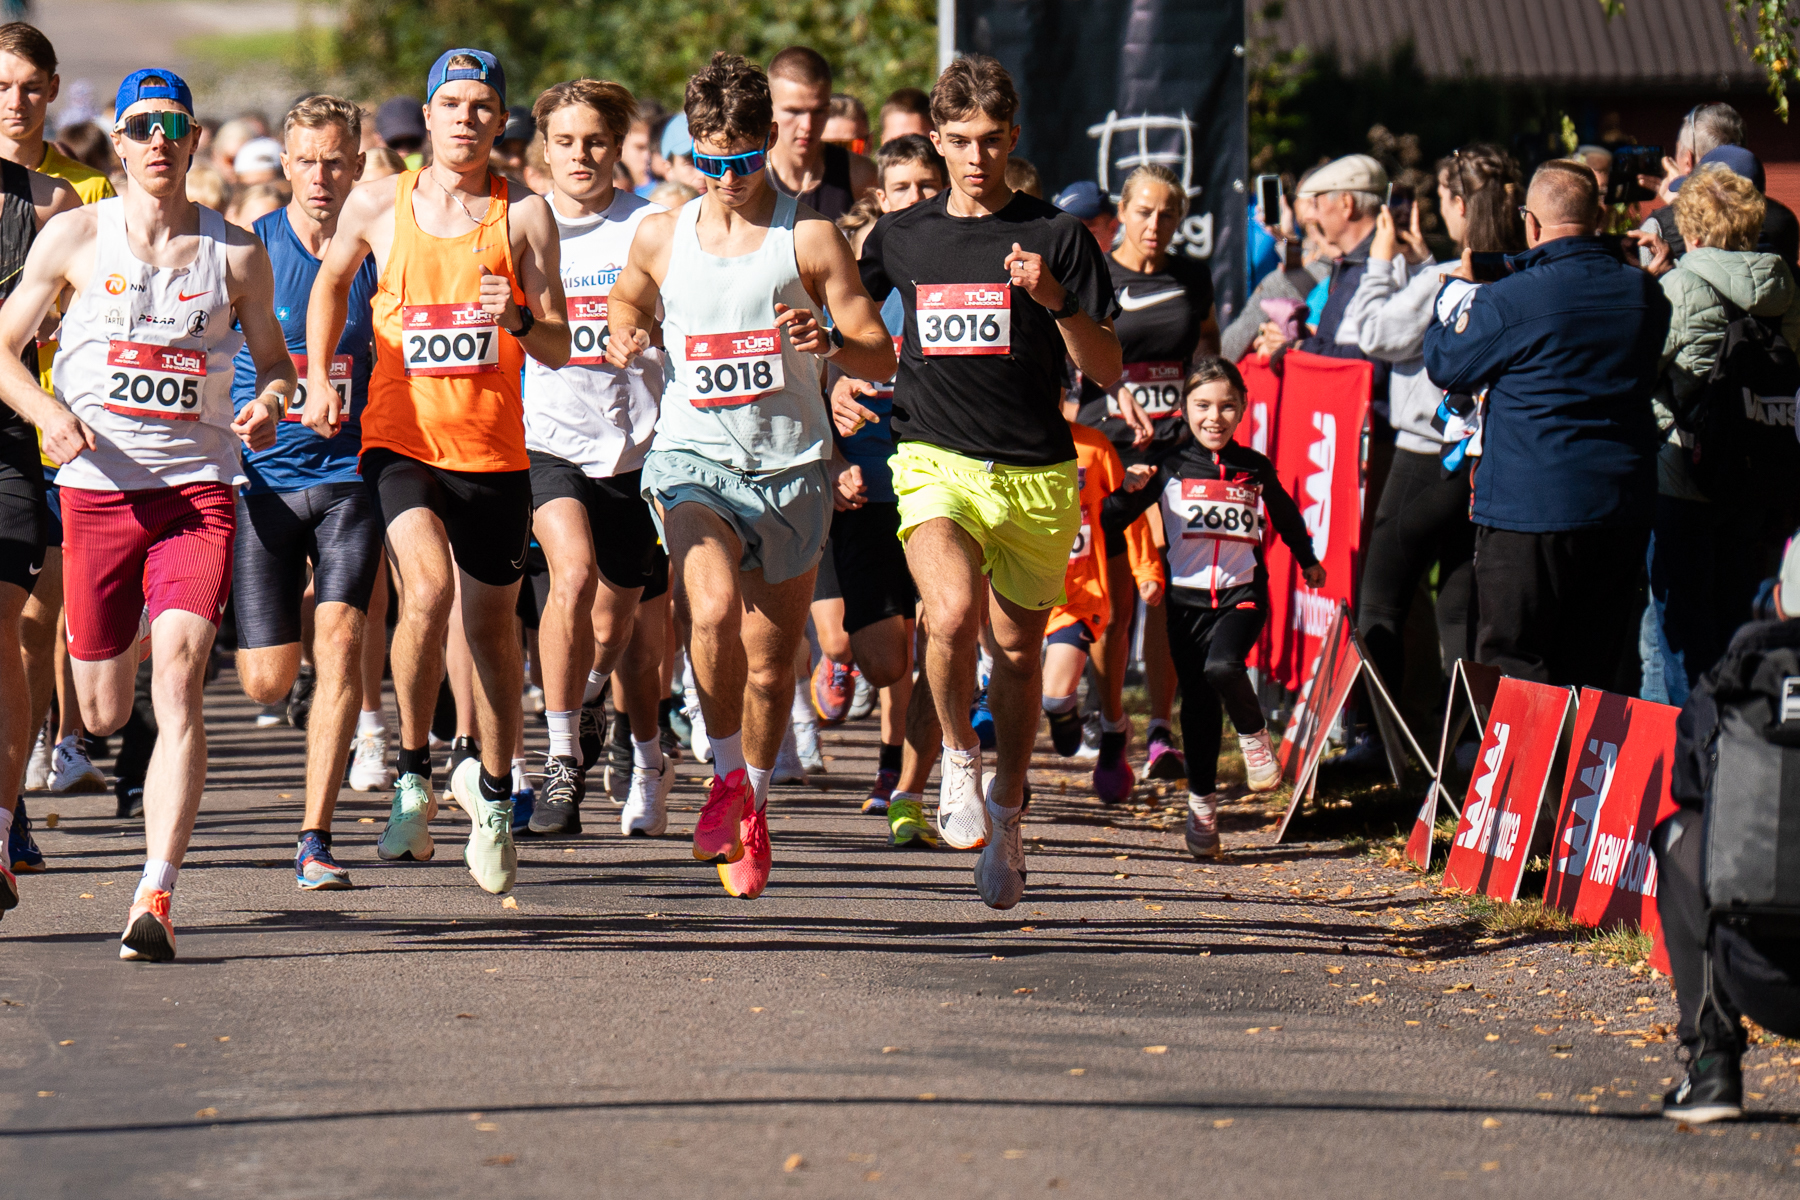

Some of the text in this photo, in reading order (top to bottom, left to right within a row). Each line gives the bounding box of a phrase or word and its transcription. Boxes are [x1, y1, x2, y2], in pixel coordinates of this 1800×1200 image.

[574, 301, 608, 313] TÜR
[964, 289, 1004, 302] TÜRI
[925, 314, 1001, 342] 3016
[409, 331, 492, 363] 2007
[731, 336, 774, 350] TÜRI
[161, 353, 200, 369] TÜRI
[109, 371, 199, 409] 2005
[695, 361, 773, 394] 3018
[1117, 384, 1180, 410] 010
[1742, 386, 1797, 427] VANS
[1186, 504, 1254, 533] 2689
[1589, 824, 1658, 898] new balan
